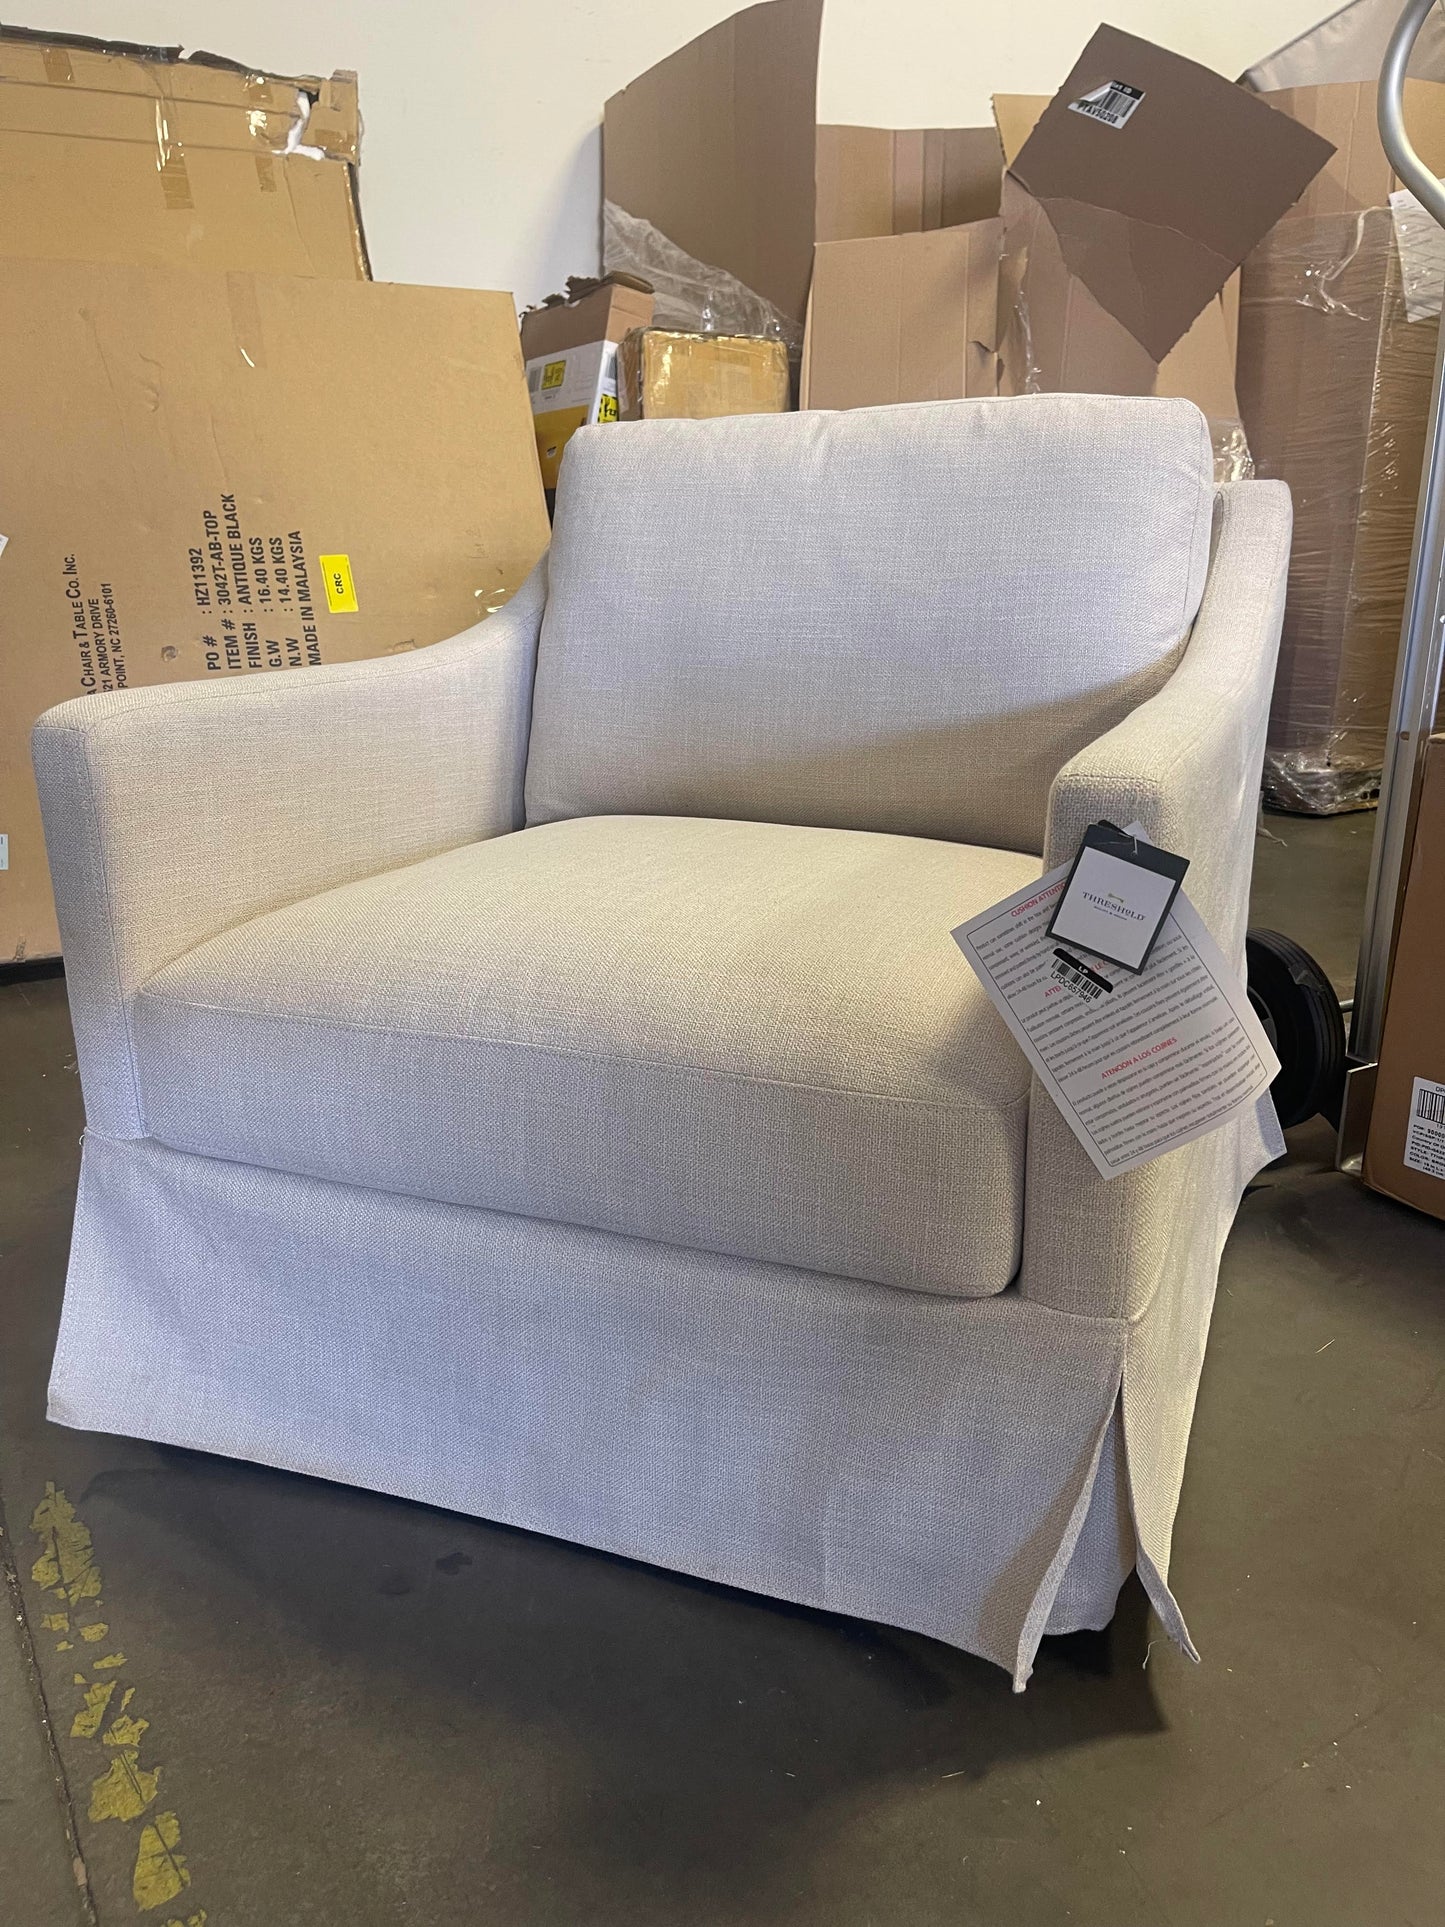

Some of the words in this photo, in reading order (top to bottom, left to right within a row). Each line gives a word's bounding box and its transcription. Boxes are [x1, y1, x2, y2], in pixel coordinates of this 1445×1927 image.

[221, 493, 241, 539] BLACK
[203, 510, 231, 605] 3042T-AB-TOP
[249, 537, 265, 564] KGS
[269, 537, 285, 564] KGS
[189, 548, 210, 606] HZ11392
[229, 543, 252, 605] ANTIQUE
[288, 531, 311, 602] MALAYSIA
[255, 568, 271, 603] 16.40
[275, 568, 291, 603] 14.40
[333, 573, 344, 594] CRC
[88, 598, 103, 629] DRIVE
[101, 583, 120, 636] 27260-6101
[221, 618, 235, 630] #
[300, 606, 314, 621] IN
[79, 641, 90, 649] &
[95, 631, 111, 676] ARMORY
[111, 638, 122, 652] NC
[203, 635, 217, 647] #
[224, 636, 242, 669] ITEM
[242, 622, 262, 668] FINISH
[266, 639, 282, 667] G.W
[286, 638, 302, 666] N.W
[303, 625, 322, 666] MADE
[114, 655, 128, 688] POINT,
[208, 652, 221, 670] PO
[1010, 899, 1038, 917] CUSHION
[1078, 965, 1089, 974] LP
[1050, 971, 1092, 1003] LPDC657946
[1138, 1049, 1151, 1060] LOS
[1151, 1036, 1178, 1054] COJINES
